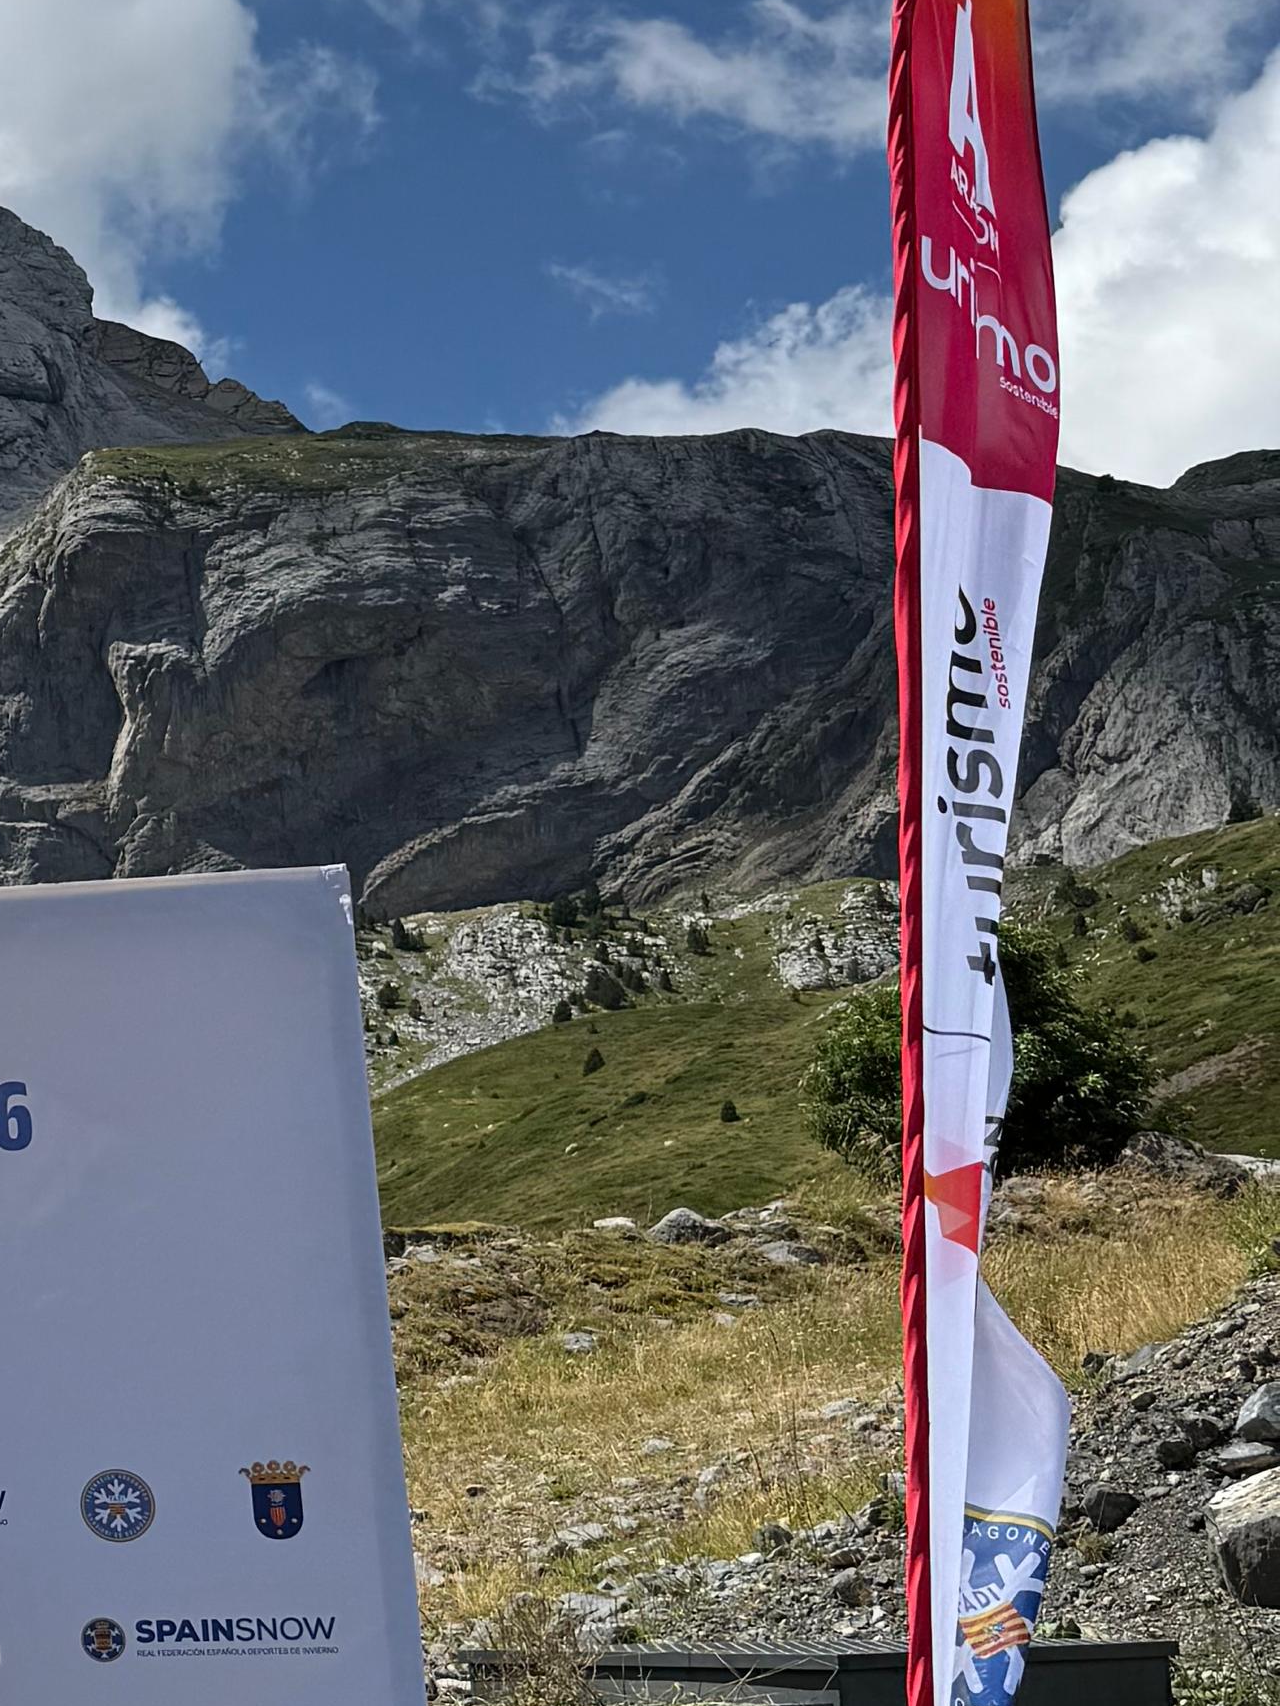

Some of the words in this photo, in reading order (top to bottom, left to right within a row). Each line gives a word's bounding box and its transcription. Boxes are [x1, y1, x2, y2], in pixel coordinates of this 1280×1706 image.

[921, 233, 1057, 394] urimo
[980, 596, 1012, 711] sostenible
[135, 1616, 336, 1643] SPAINSNOW
